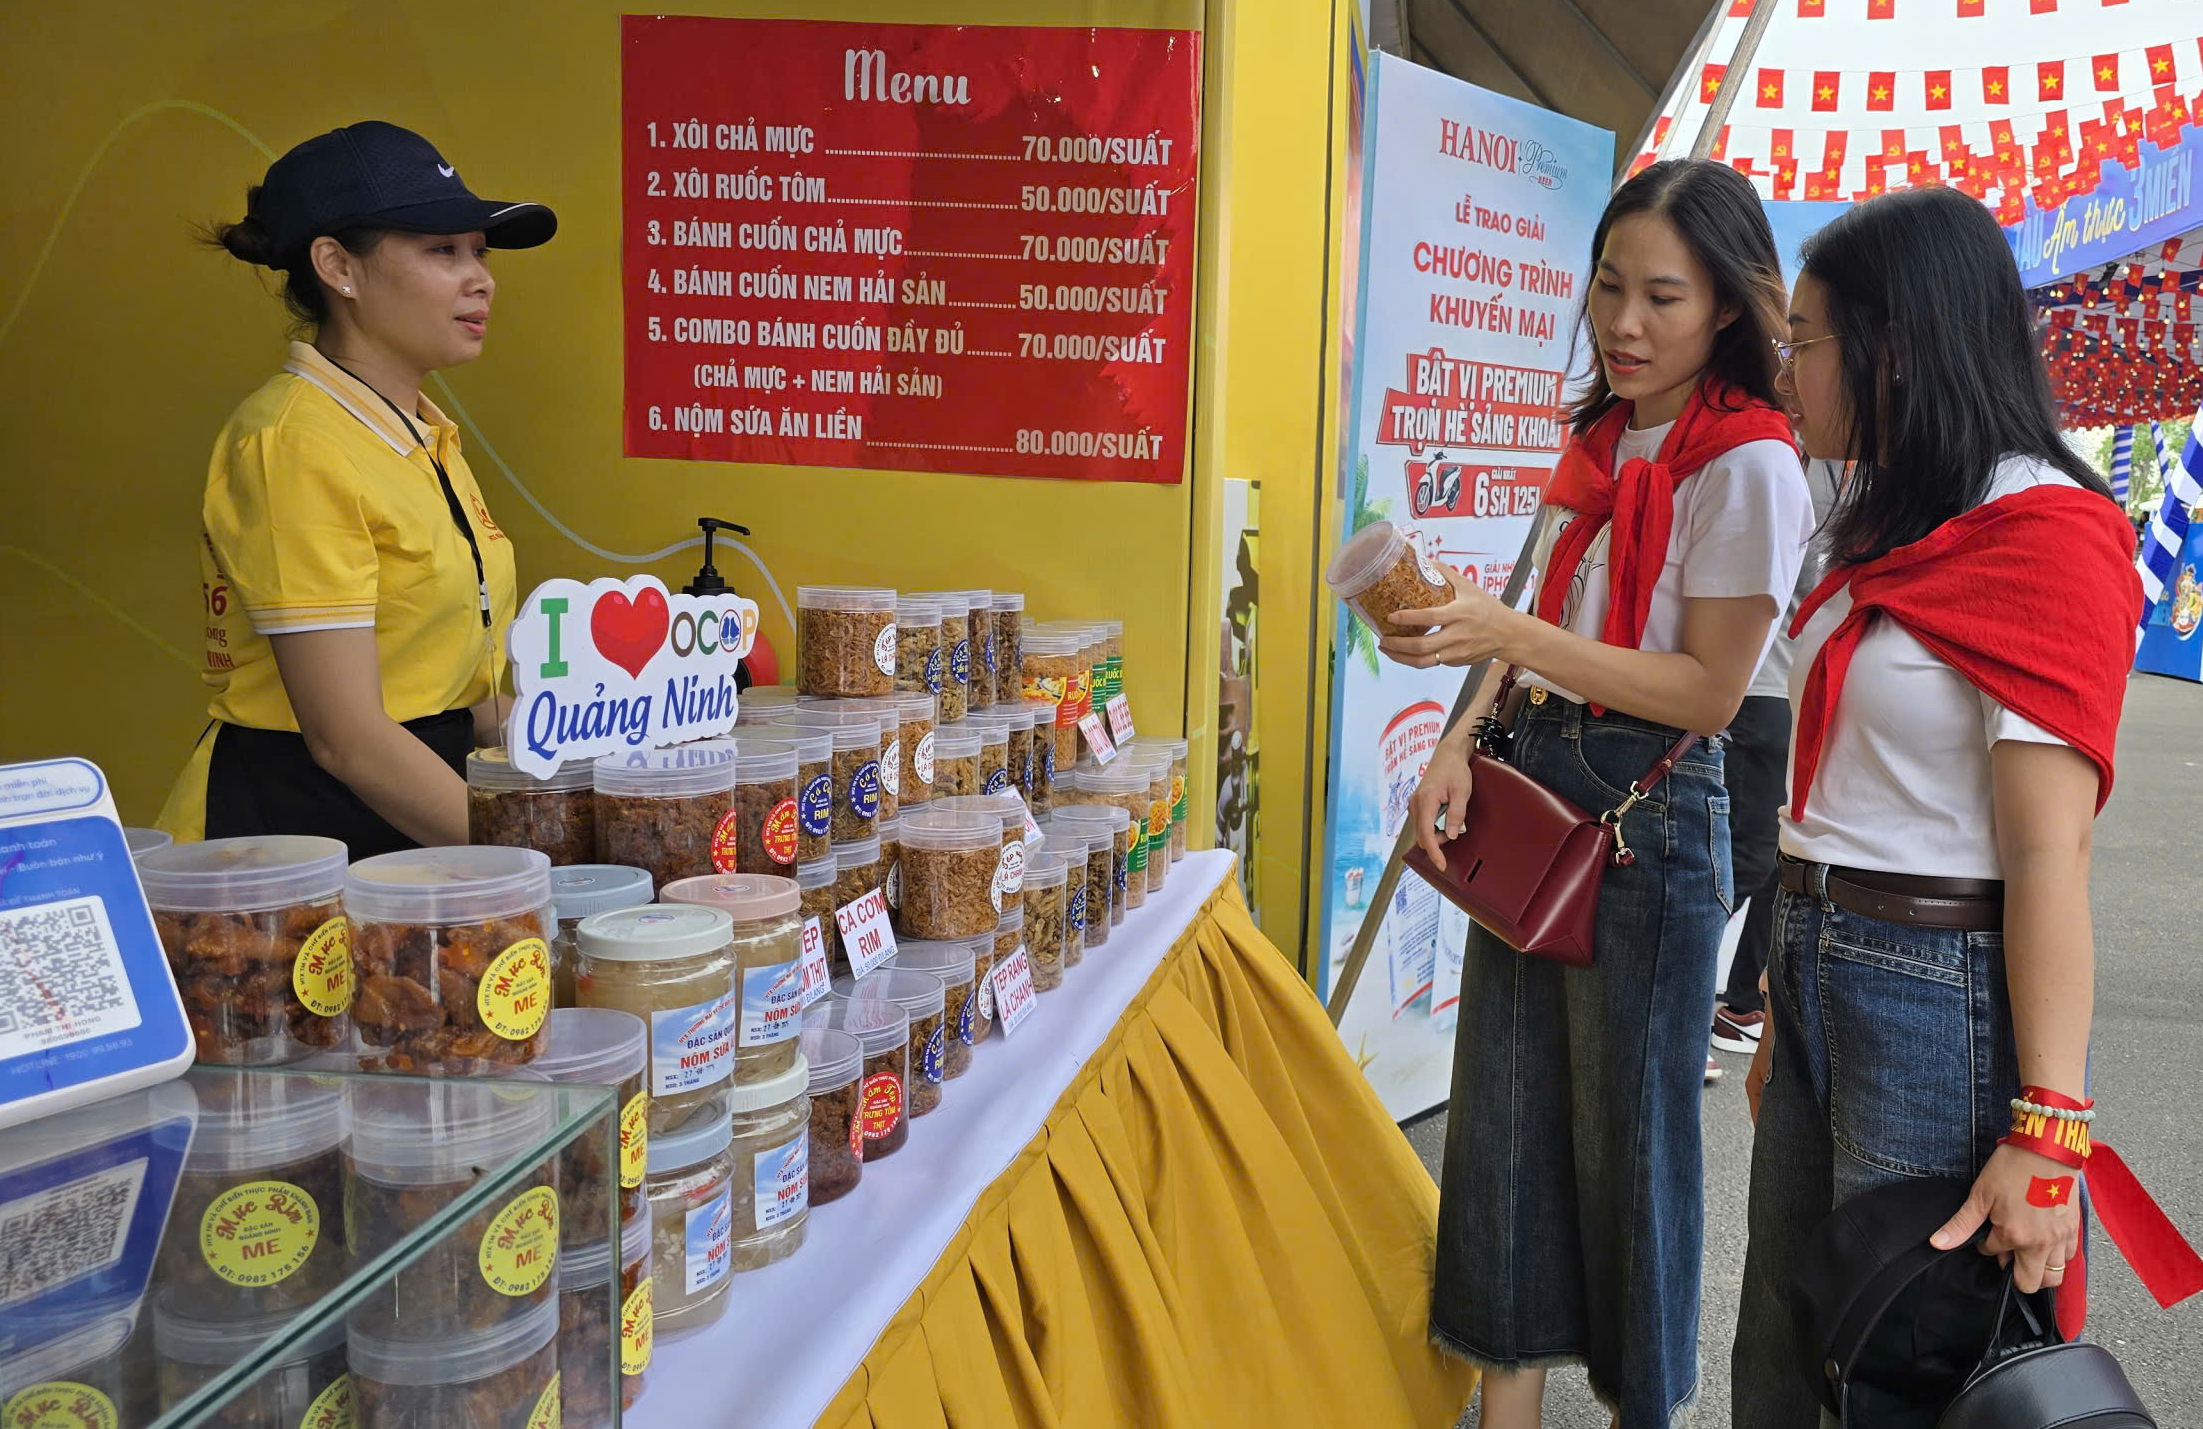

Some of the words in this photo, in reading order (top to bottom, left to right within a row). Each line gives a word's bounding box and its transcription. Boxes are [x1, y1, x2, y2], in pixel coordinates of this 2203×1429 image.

[844, 48, 971, 104] Menu
[647, 122, 666, 148] 1.
[673, 118, 708, 149] XÔI
[715, 117, 758, 151] CHẢ
[766, 124, 814, 158] MỰC
[1022, 130, 1172, 165] 70.000/SUẤT
[1439, 117, 1518, 174] HANOI
[1522, 139, 1568, 179] Premium
[647, 171, 666, 197] 2.
[673, 167, 708, 198] XÔI
[715, 166, 773, 201] RUỐC
[779, 172, 826, 204] TÔM
[1021, 180, 1171, 216] 50.000/SUẤT
[647, 220, 667, 245] 3.
[673, 216, 732, 248] BÁNH
[739, 215, 797, 251] CUỐN
[804, 218, 848, 253] CHẢ
[854, 227, 903, 261] MỰC
[1020, 230, 1169, 266] 70.000/SUẤT
[1456, 193, 1471, 224] LỄ
[1475, 206, 1512, 234] TRAO
[1516, 214, 1546, 241] GIẢI
[2083, 197, 2126, 244] thực
[647, 268, 667, 294] 4.
[673, 264, 732, 297] BÁNH
[739, 264, 797, 299] CUỐN
[804, 275, 852, 302] NEM
[859, 269, 895, 304] HẢI
[901, 271, 946, 306] SẢN
[1019, 279, 1168, 315] 50.000/SUẤT
[1413, 241, 1513, 288] CHƯƠNG
[1519, 258, 1573, 299] TRÌNH
[648, 316, 667, 342] 5.
[674, 317, 751, 346] COMBO
[757, 316, 815, 349] BÁNH
[822, 316, 881, 351] CUỐN
[886, 318, 929, 354] ĐẦY
[935, 321, 964, 355] ĐỦ
[1018, 328, 1167, 364] 70.000/SUẤT
[1429, 292, 1513, 334] KHUYẾN
[1518, 308, 1556, 348] MẠI
[694, 358, 739, 388] (CHẢ
[744, 365, 786, 395] MỰC
[812, 369, 853, 393] NEM
[860, 365, 891, 395] HẢI
[896, 366, 942, 399] SẢN)
[1416, 351, 1454, 407] BẬT
[1460, 363, 1478, 411] VỊ
[1481, 366, 1558, 407] PREMIUM
[648, 405, 668, 431] 6.
[674, 402, 723, 437] NỘM
[730, 404, 773, 436] SỨA
[779, 406, 808, 437] ĂN
[815, 406, 862, 440] LIỀN
[1016, 426, 1163, 460] 80.000/SUẤT
[1392, 405, 1441, 451] TRỌN
[1444, 402, 1468, 443] HÈ
[1471, 403, 1515, 446] SẢNG
[1474, 472, 1490, 517] 6
[1490, 485, 1511, 516] SH
[207, 627, 227, 647] ong
[540, 598, 568, 678] I
[527, 682, 653, 761] Quảng
[662, 674, 734, 729] Ninh
[814, 808, 829, 820] RIM
[0, 842, 25, 853] anh
[838, 904, 857, 935] CÁ
[857, 892, 887, 924] CƠM
[858, 928, 882, 958] RIM
[1008, 952, 1027, 981] RANG
[327, 969, 345, 992] ME
[514, 991, 538, 1015] ME
[216, 1200, 258, 1241] Mực
[241, 1237, 282, 1261] ME
[516, 1244, 543, 1269] ME
[237, 1274, 268, 1283] 0982
